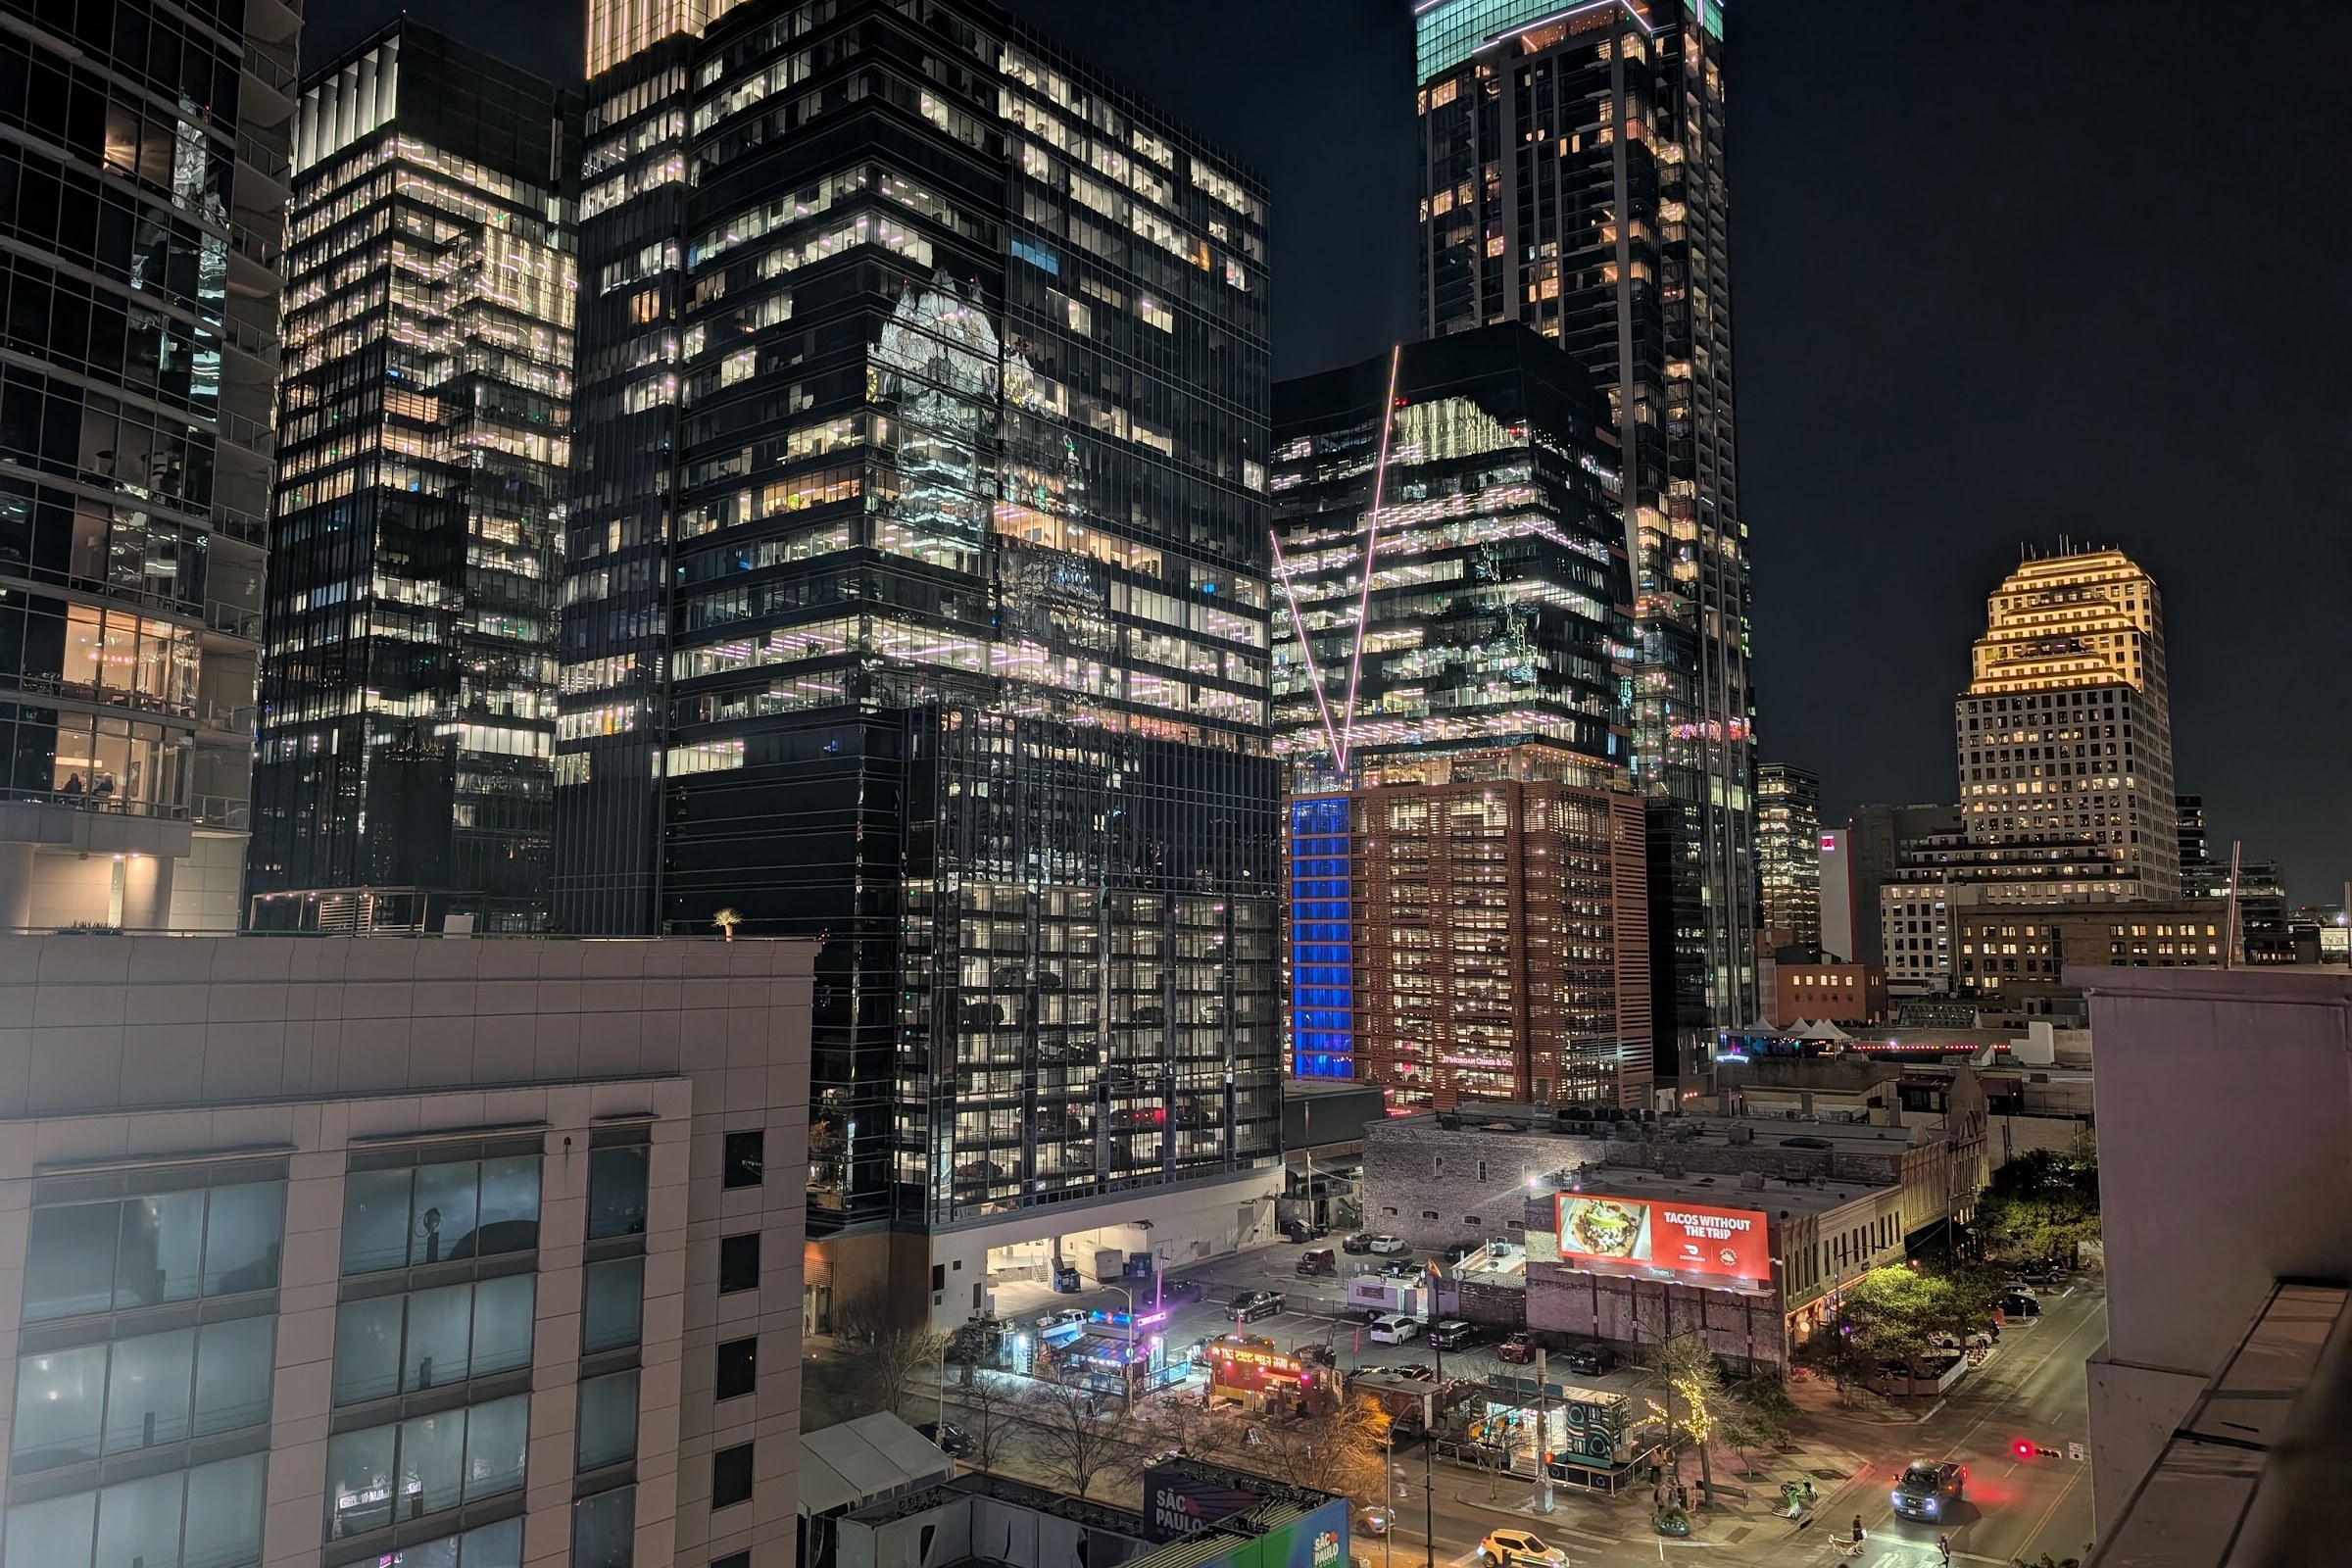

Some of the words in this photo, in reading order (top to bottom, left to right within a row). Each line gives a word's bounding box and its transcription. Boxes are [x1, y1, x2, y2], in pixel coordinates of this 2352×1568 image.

[1664, 1212, 1698, 1225] TACOS
[1698, 1215, 1750, 1231] WITHOUT
[1685, 1225, 1705, 1238] THE
[1706, 1227, 1732, 1240] TRIP
[1156, 1487, 1187, 1513] SÃO
[1156, 1507, 1203, 1533] PAULO
[1314, 1531, 1331, 1551] SÃO
[1314, 1543, 1339, 1566] PAULO
